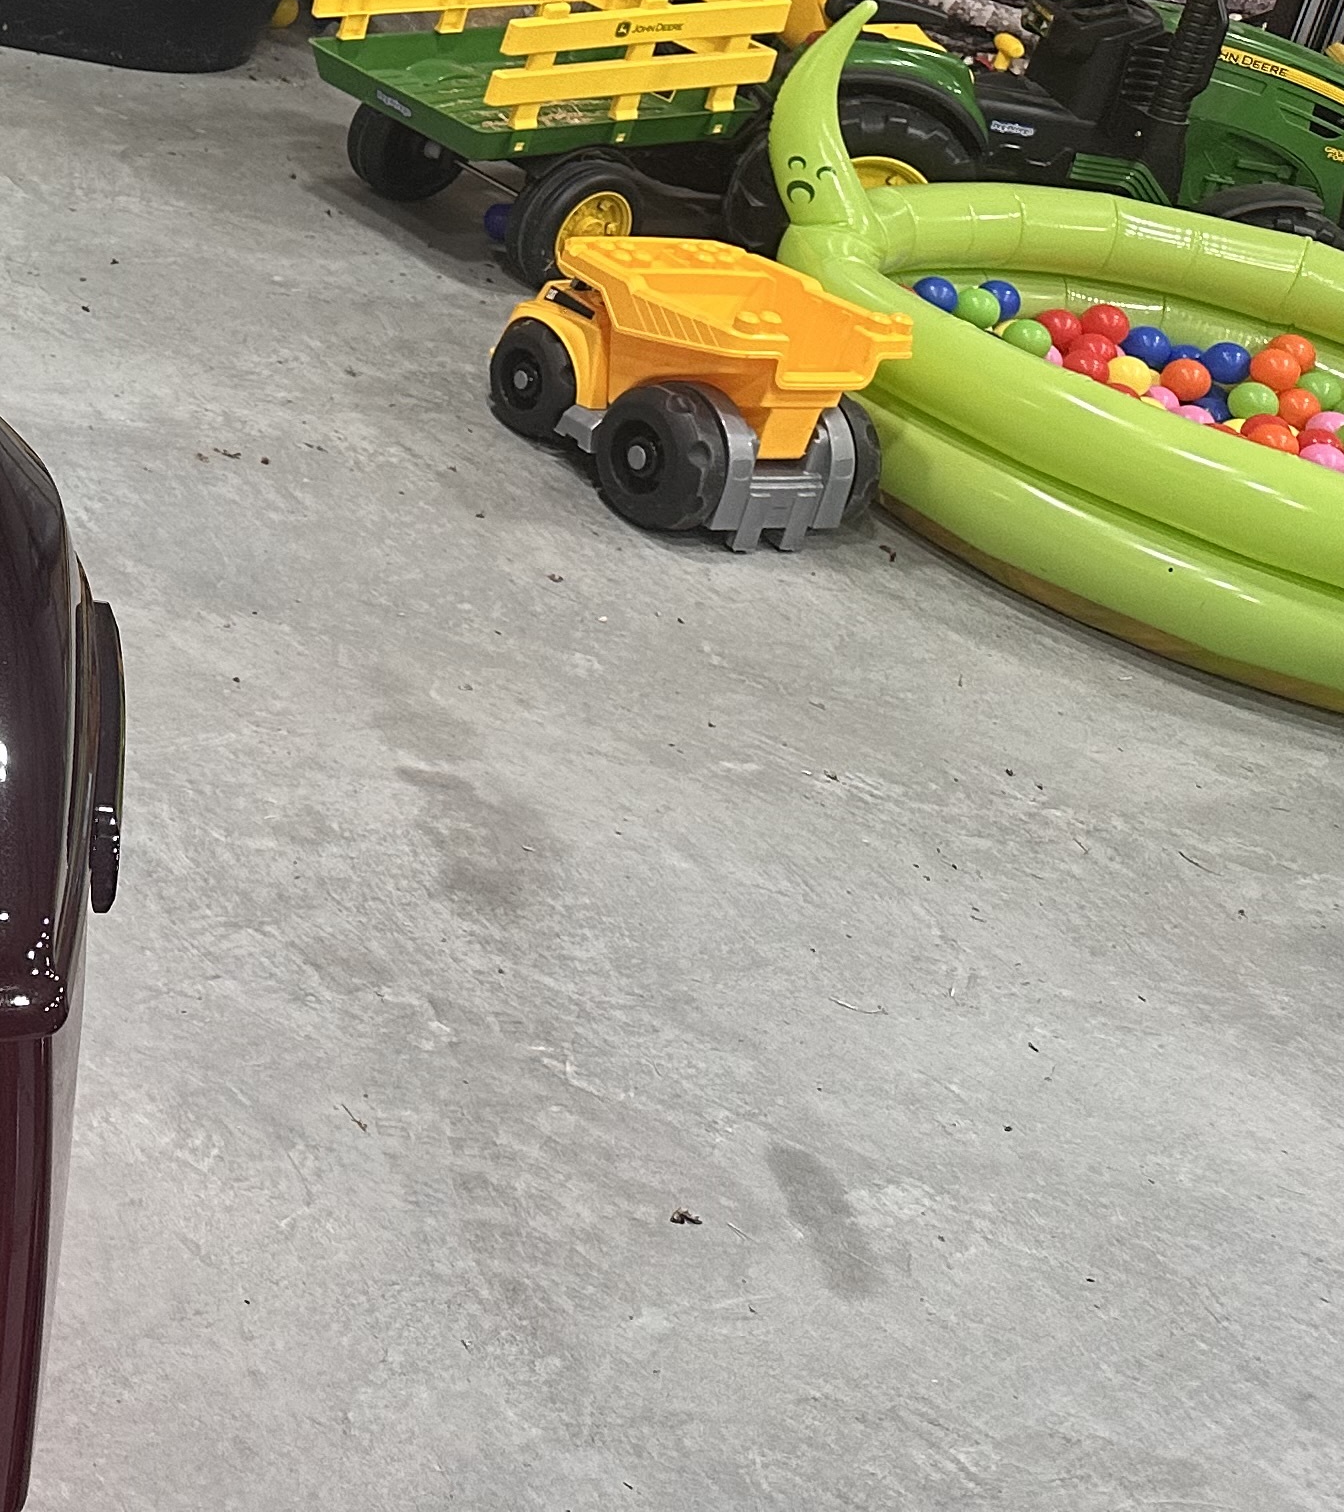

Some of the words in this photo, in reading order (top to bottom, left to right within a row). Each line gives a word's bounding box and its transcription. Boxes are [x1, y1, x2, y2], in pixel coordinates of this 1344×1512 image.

[631, 24, 655, 34] JOHN
[656, 22, 684, 33] DEERE
[1219, 51, 1240, 63] HN
[1241, 54, 1290, 78] DEERE
